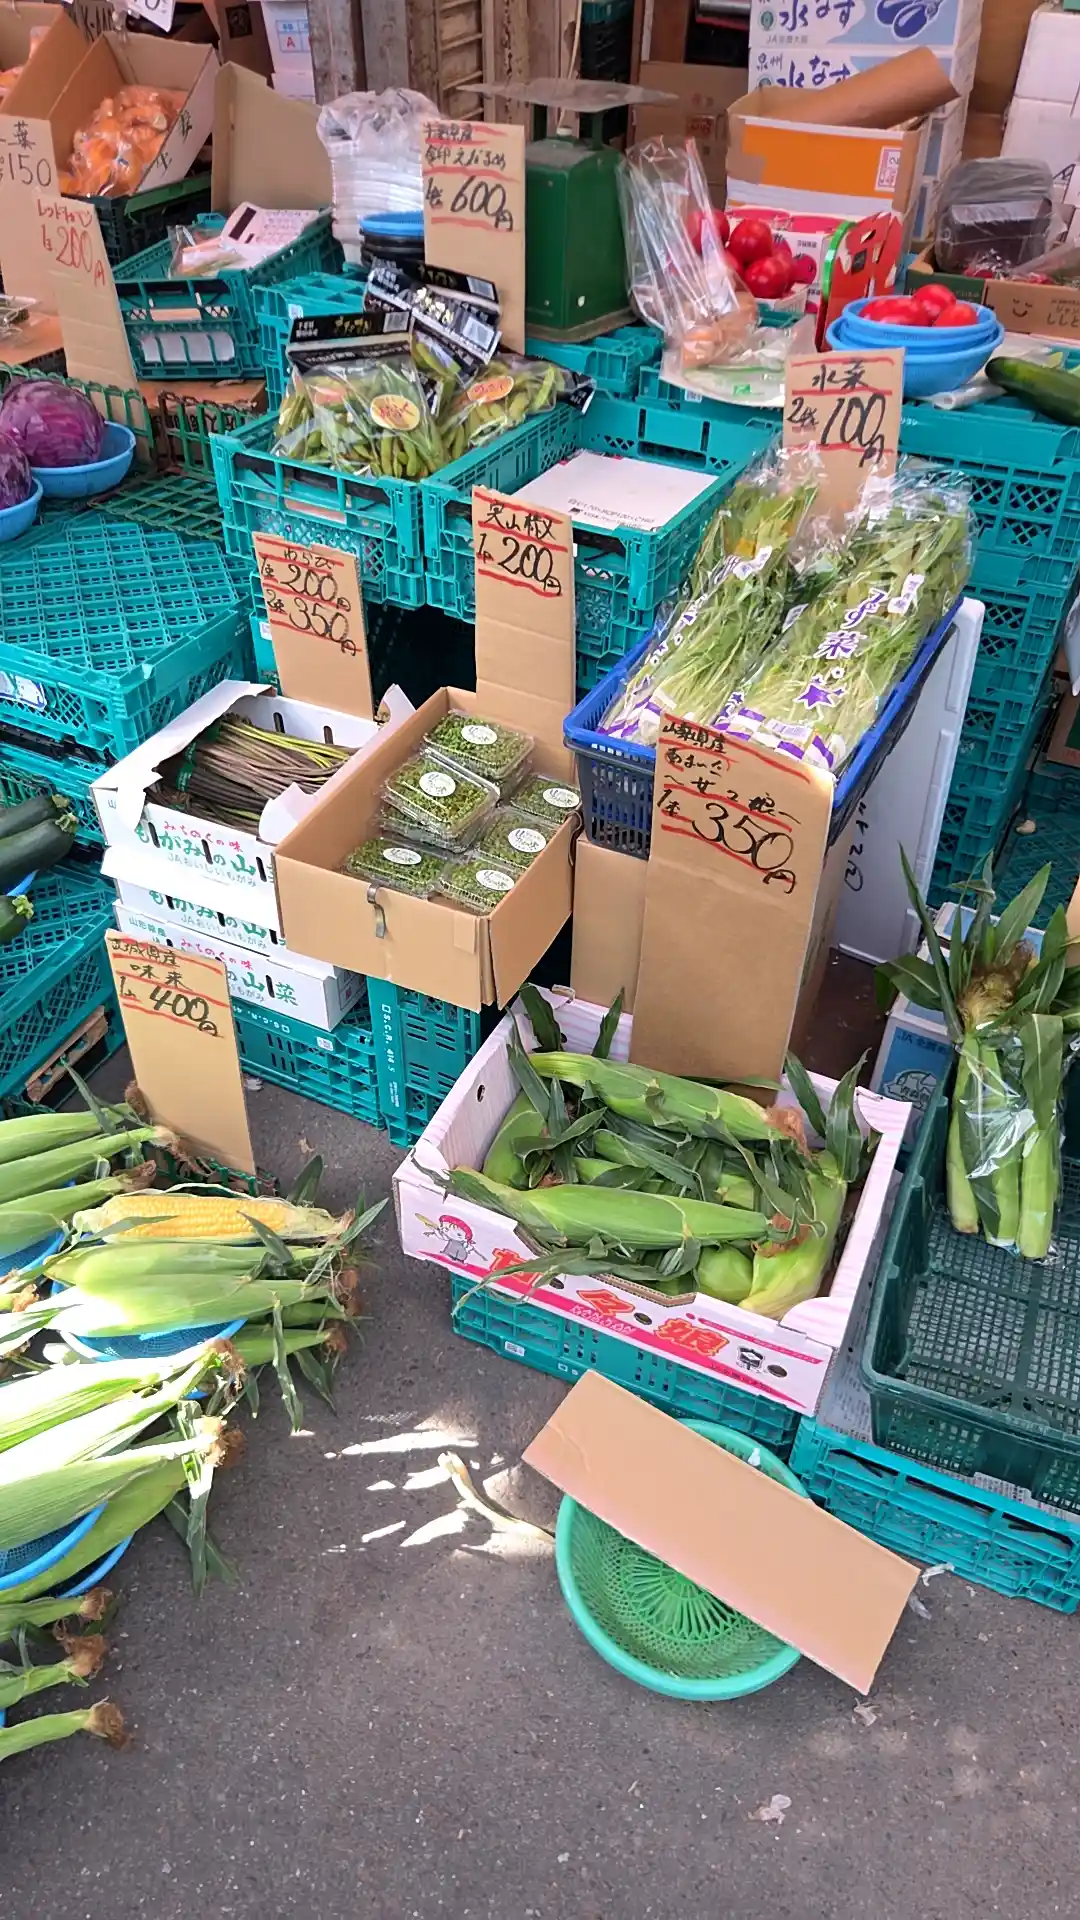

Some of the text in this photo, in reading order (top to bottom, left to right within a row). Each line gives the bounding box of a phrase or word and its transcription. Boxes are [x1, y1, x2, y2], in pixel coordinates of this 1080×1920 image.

[135, 823, 274, 883] もがみの山
